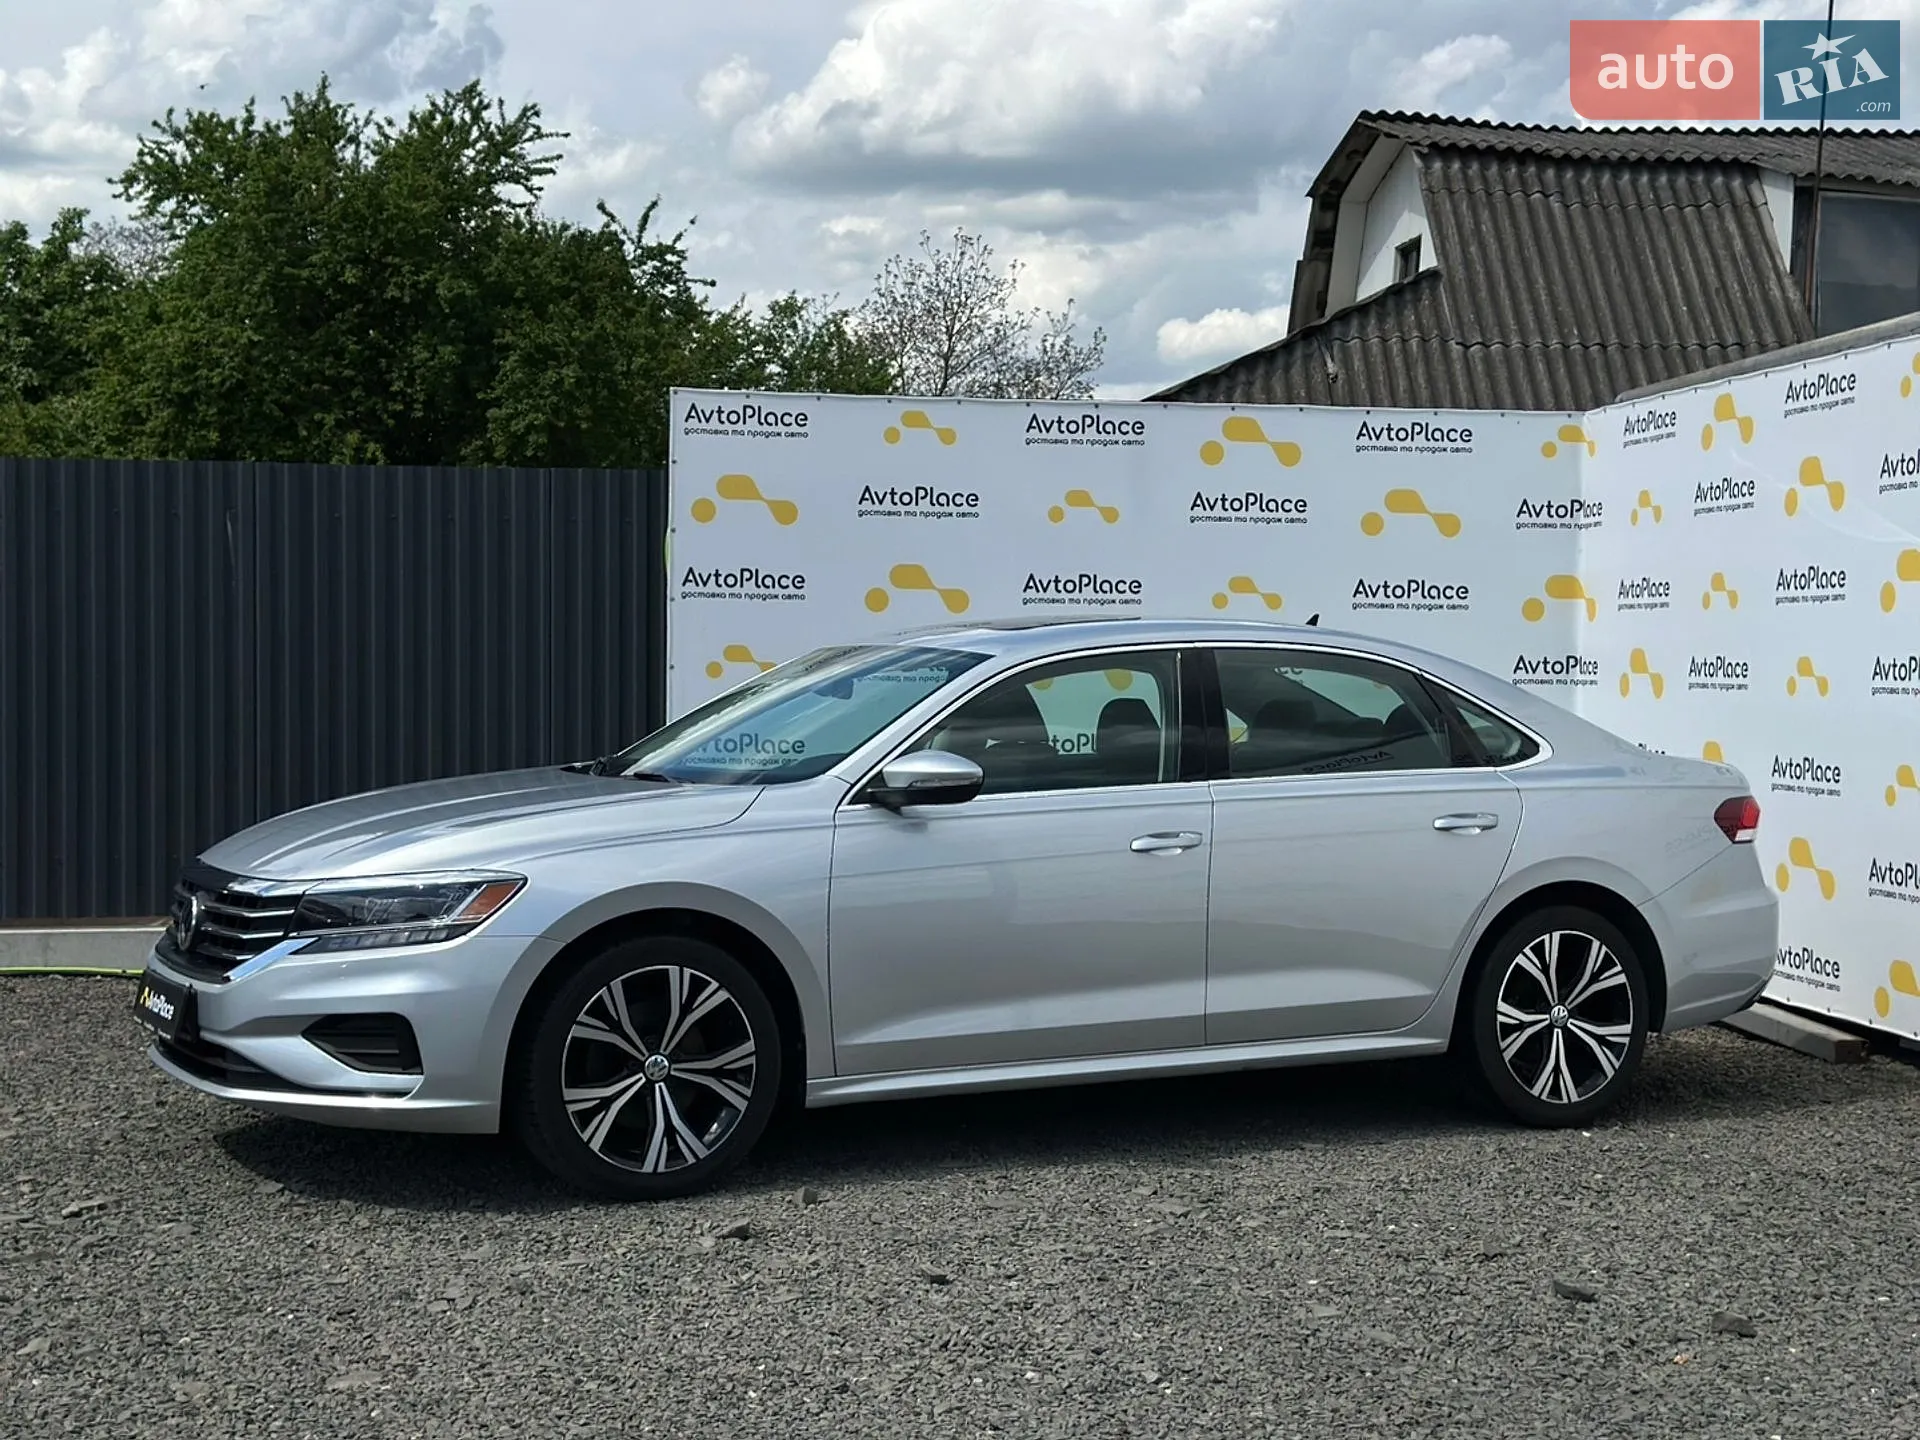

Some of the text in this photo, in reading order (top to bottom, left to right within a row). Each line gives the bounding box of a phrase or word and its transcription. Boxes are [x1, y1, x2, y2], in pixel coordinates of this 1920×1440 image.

[1785, 373, 1856, 404] AvtoPlace
[684, 402, 809, 427] AvtoPlace
[1026, 413, 1145, 436] AvtoPlace
[1623, 410, 1676, 436] AvtoPlace
[1356, 420, 1473, 443] AvtoPlace
[858, 485, 979, 507] AvtoPlace
[1694, 477, 1755, 503] AvtoPlace
[1190, 491, 1307, 513] AvtoPlace
[1516, 498, 1602, 519] AvtoPlace
[682, 567, 805, 590] AvtoPlace
[1023, 573, 1142, 595] AvtoPlace
[1352, 578, 1469, 600] AvtoPlace
[1618, 577, 1670, 599] AvtoPlace
[1776, 566, 1846, 591] AvtoPlace
[1513, 655, 1598, 674] AvtoPlace
[1688, 656, 1748, 679] AvtoPlace
[1772, 755, 1841, 784] AvtoPlace
[1869, 857, 1920, 890] AvtoPl
